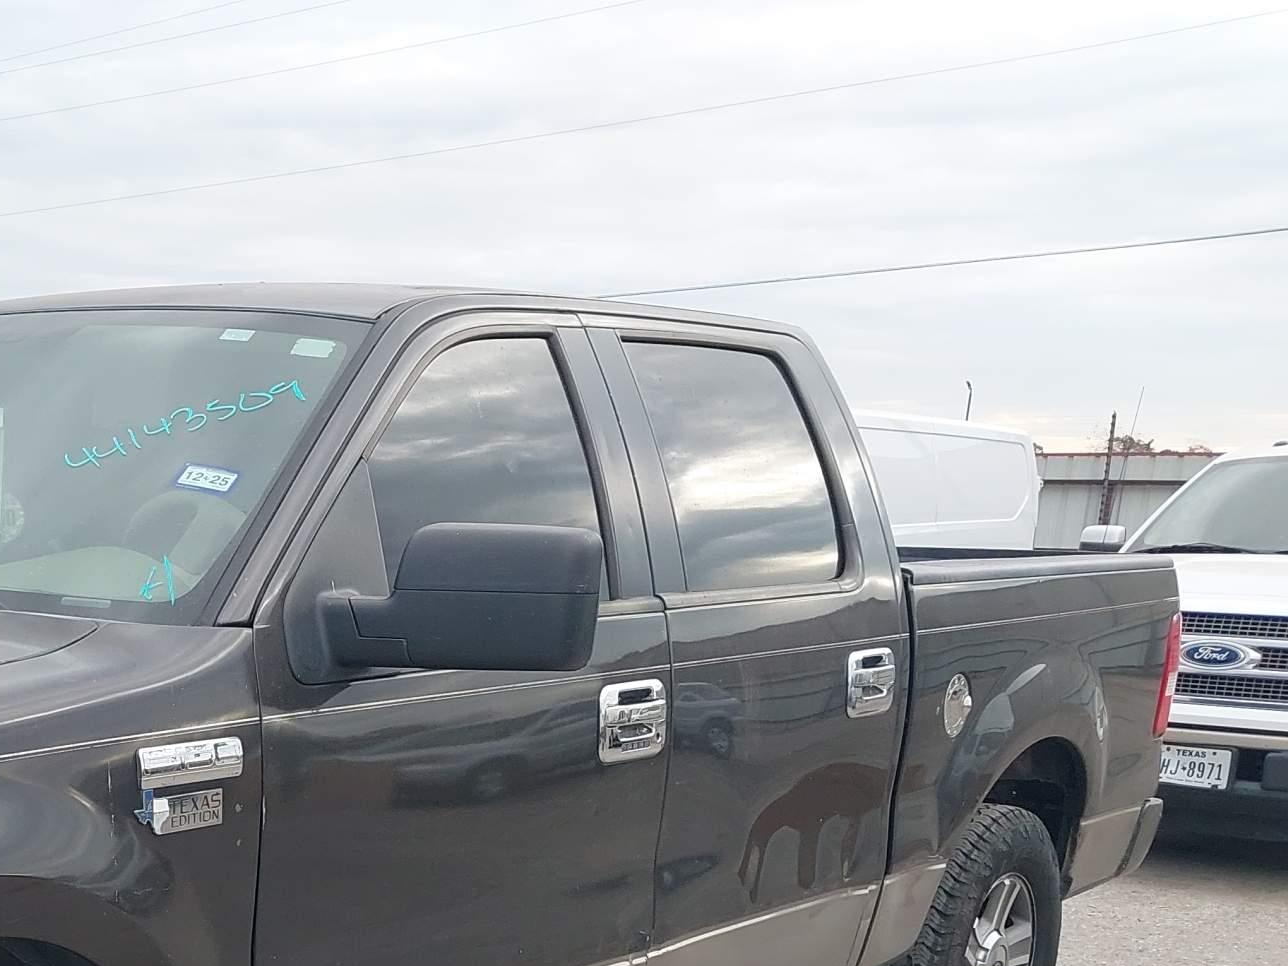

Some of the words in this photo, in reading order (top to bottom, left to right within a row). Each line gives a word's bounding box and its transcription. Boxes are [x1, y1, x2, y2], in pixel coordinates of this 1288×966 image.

[64, 380, 306, 468] 44143509
[1193, 646, 1230, 661] Ford
[1176, 749, 1206, 758] TEXAS
[168, 792, 221, 815] TEXAS
[170, 809, 220, 828] EDITION
